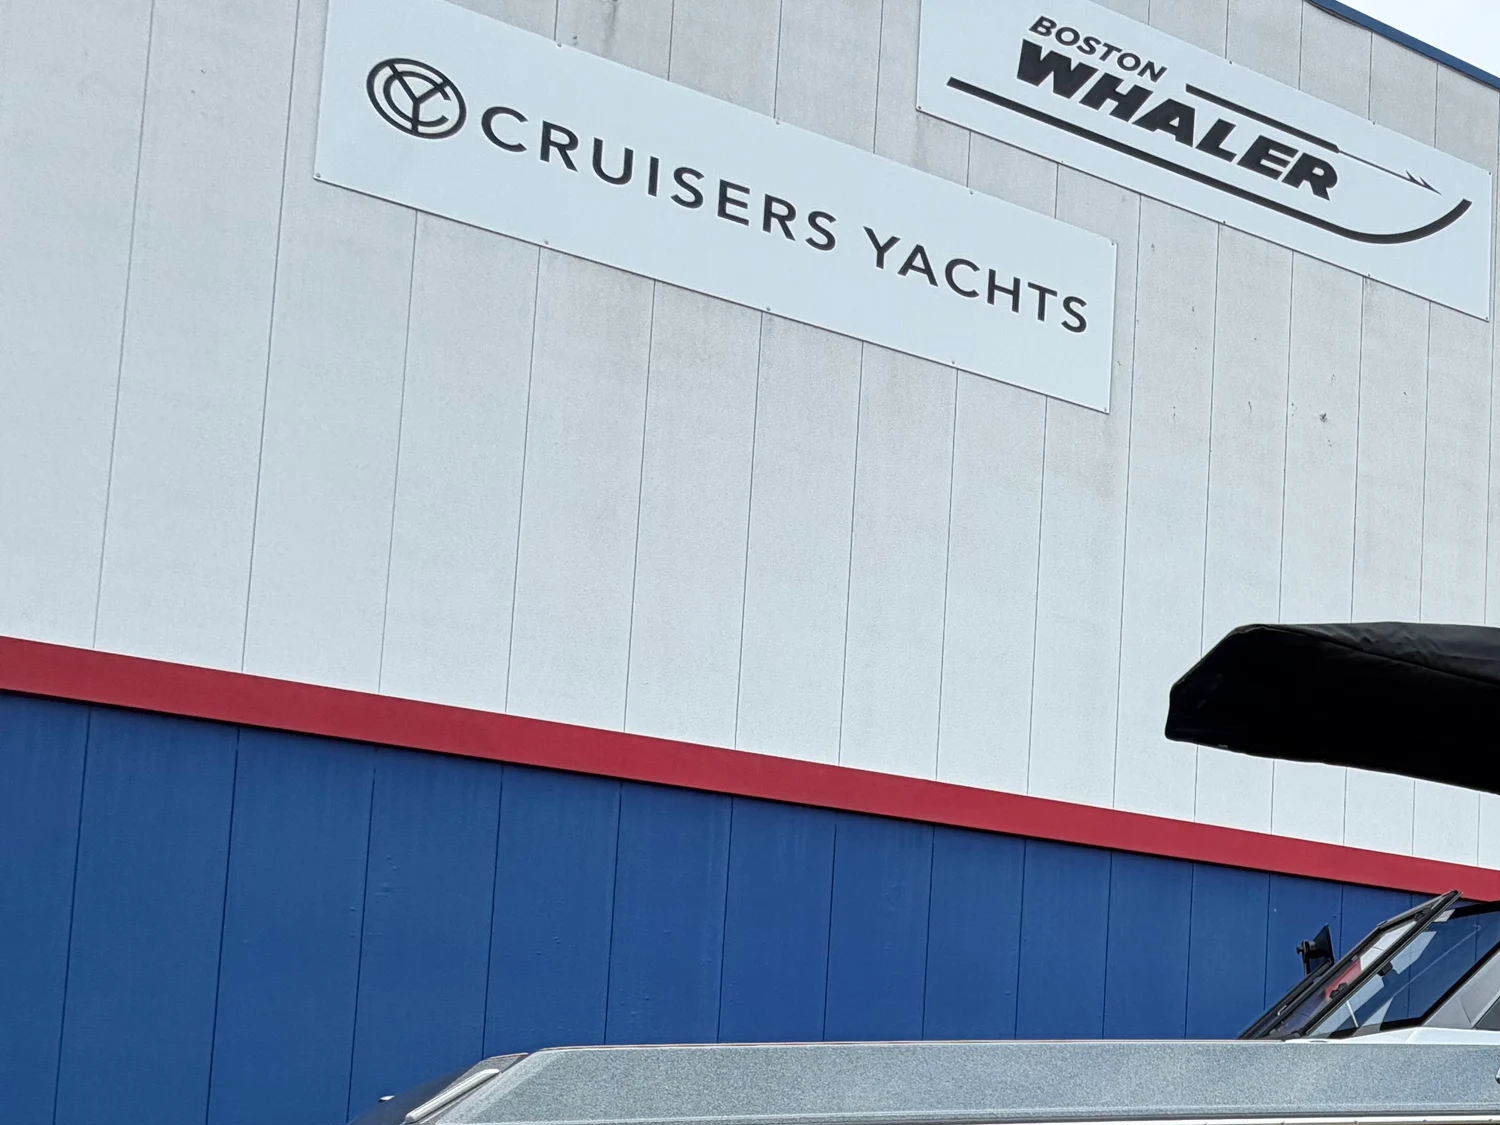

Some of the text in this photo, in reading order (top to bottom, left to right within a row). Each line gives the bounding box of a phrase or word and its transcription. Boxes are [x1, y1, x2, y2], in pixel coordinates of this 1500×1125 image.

[1016, 38, 1338, 201] WHALER
[1029, 16, 1168, 83] BOSTON
[480, 105, 837, 253] CRUISERS
[862, 226, 1088, 335] YACHTS
